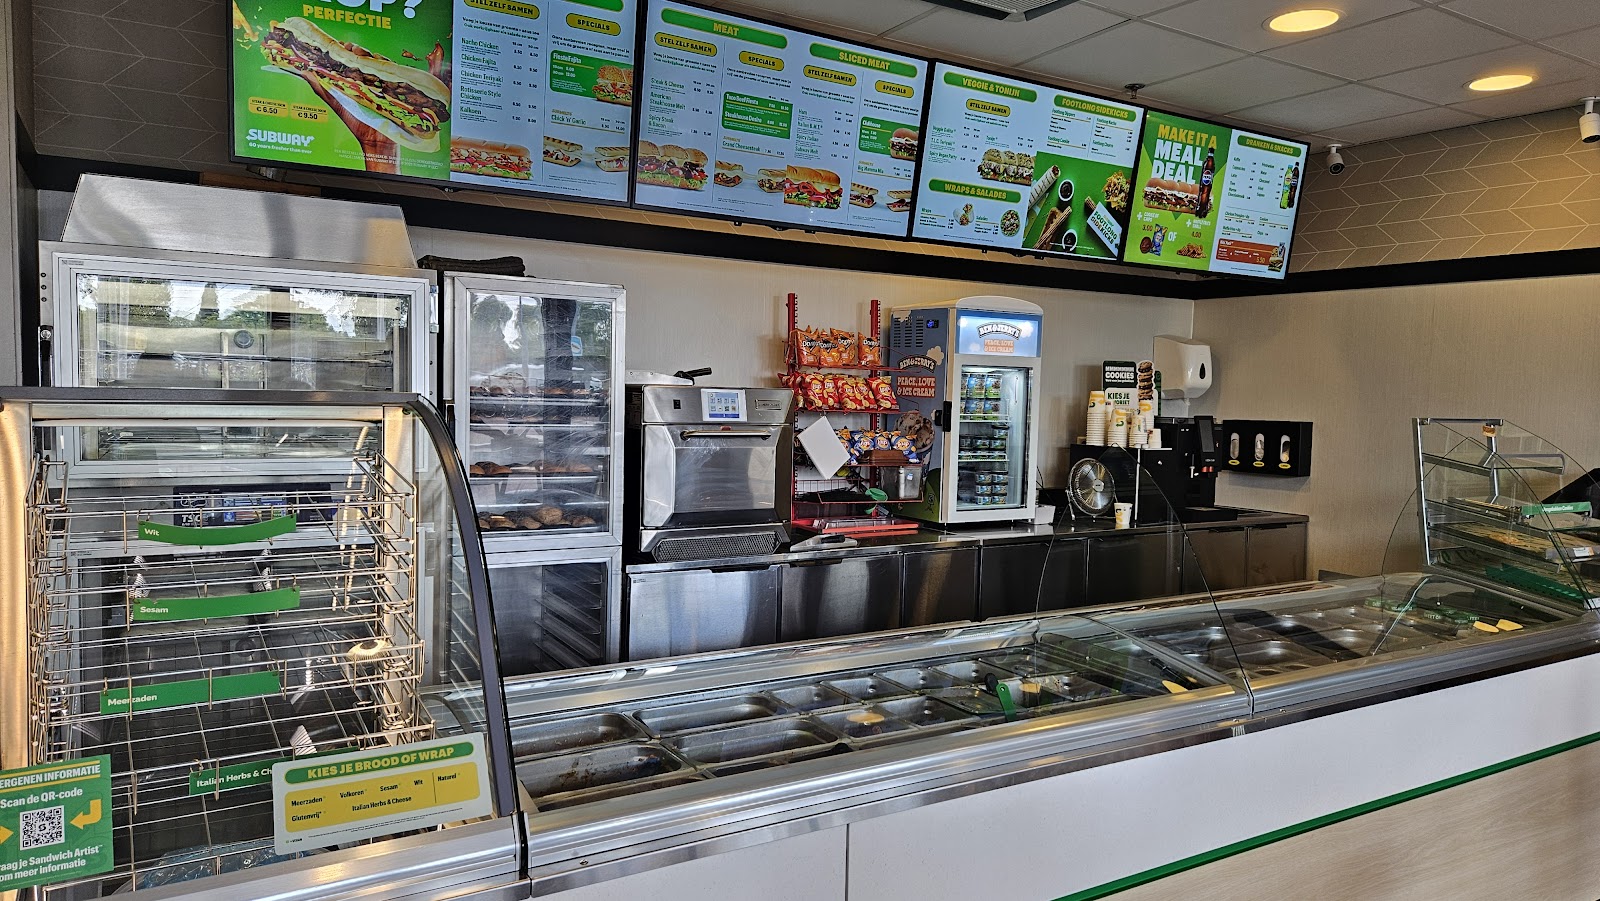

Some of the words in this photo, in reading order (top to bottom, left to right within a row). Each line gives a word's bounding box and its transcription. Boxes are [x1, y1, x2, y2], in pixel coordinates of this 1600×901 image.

[488, 0, 506, 9] ZELF
[507, 4, 533, 15] SAMEN
[302, 4, 392, 30] PERFECTIE
[577, 19, 610, 30] SPECIALS
[713, 22, 739, 36] MEAT
[461, 38, 478, 46] Nacho
[478, 40, 500, 50] Chicken
[660, 36, 675, 44] STEL
[676, 40, 690, 48] ZELF
[691, 44, 712, 53] SAMEN
[461, 54, 482, 62] Chicken
[482, 56, 496, 66] Fajita
[748, 56, 776, 66] SPECIALS
[839, 52, 868, 65] SLICED
[868, 58, 890, 70] MEAT
[460, 70, 482, 79] Chicken
[483, 73, 504, 83] Teriyaki
[668, 81, 685, 89] Cheese
[883, 84, 906, 94] SPECIALS
[963, 78, 988, 90] VEGGIE
[989, 83, 994, 91] &
[460, 86, 487, 96] Rotisserie
[487, 89, 501, 98] Style
[460, 93, 482, 101] Chicken
[650, 92, 672, 100] American
[460, 106, 482, 114] Kalkoen
[1062, 98, 1096, 112] FOOTLONG
[1096, 106, 1128, 119] SIDEKICKS
[304, 112, 318, 120] 9.50
[246, 129, 315, 147] SUBWAY
[1158, 124, 1195, 144] MAKE
[1196, 132, 1208, 146] IT
[1208, 135, 1217, 149] A
[1154, 138, 1203, 167] MEAL
[1246, 139, 1270, 149] DRANKEN
[1274, 145, 1294, 154] SNACKS
[1151, 159, 1196, 184] DEAL
[945, 183, 970, 194] WRAPS
[976, 188, 1007, 199] SALADES
[1090, 216, 1114, 244] SIDEKICKS
[1094, 211, 1118, 240] FOOTLONG
[1168, 231, 1177, 242] OF
[918, 378, 935, 387] LOVE
[897, 387, 902, 395] &
[912, 388, 934, 397] CREAM
[144, 528, 160, 536] Wit
[108, 695, 158, 706] Meerzaden
[308, 766, 338, 779] KIES
[340, 763, 354, 774] JE
[355, 754, 400, 772] BROOD
[401, 754, 418, 764] OF
[418, 747, 454, 762] WRAP
[44, 765, 100, 783] INFORMATIE
[197, 777, 224, 787] Italian
[226, 772, 252, 783] Herbs
[261, 768, 272, 776] Ch
[438, 773, 456, 782] Naturel
[340, 790, 365, 798] Volkoren
[380, 783, 399, 792] Sesam
[0, 798, 26, 808] Scan
[27, 795, 39, 804] de
[41, 787, 83, 802] QR-code
[291, 797, 323, 807] Meerzaden
[370, 801, 386, 809] Herbs
[392, 796, 412, 804] Cheese
[19, 859, 28, 870] je
[29, 850, 73, 866] Sandwich
[0, 874, 13, 882] om
[14, 868, 39, 879] meer
[39, 858, 86, 874] informatie
